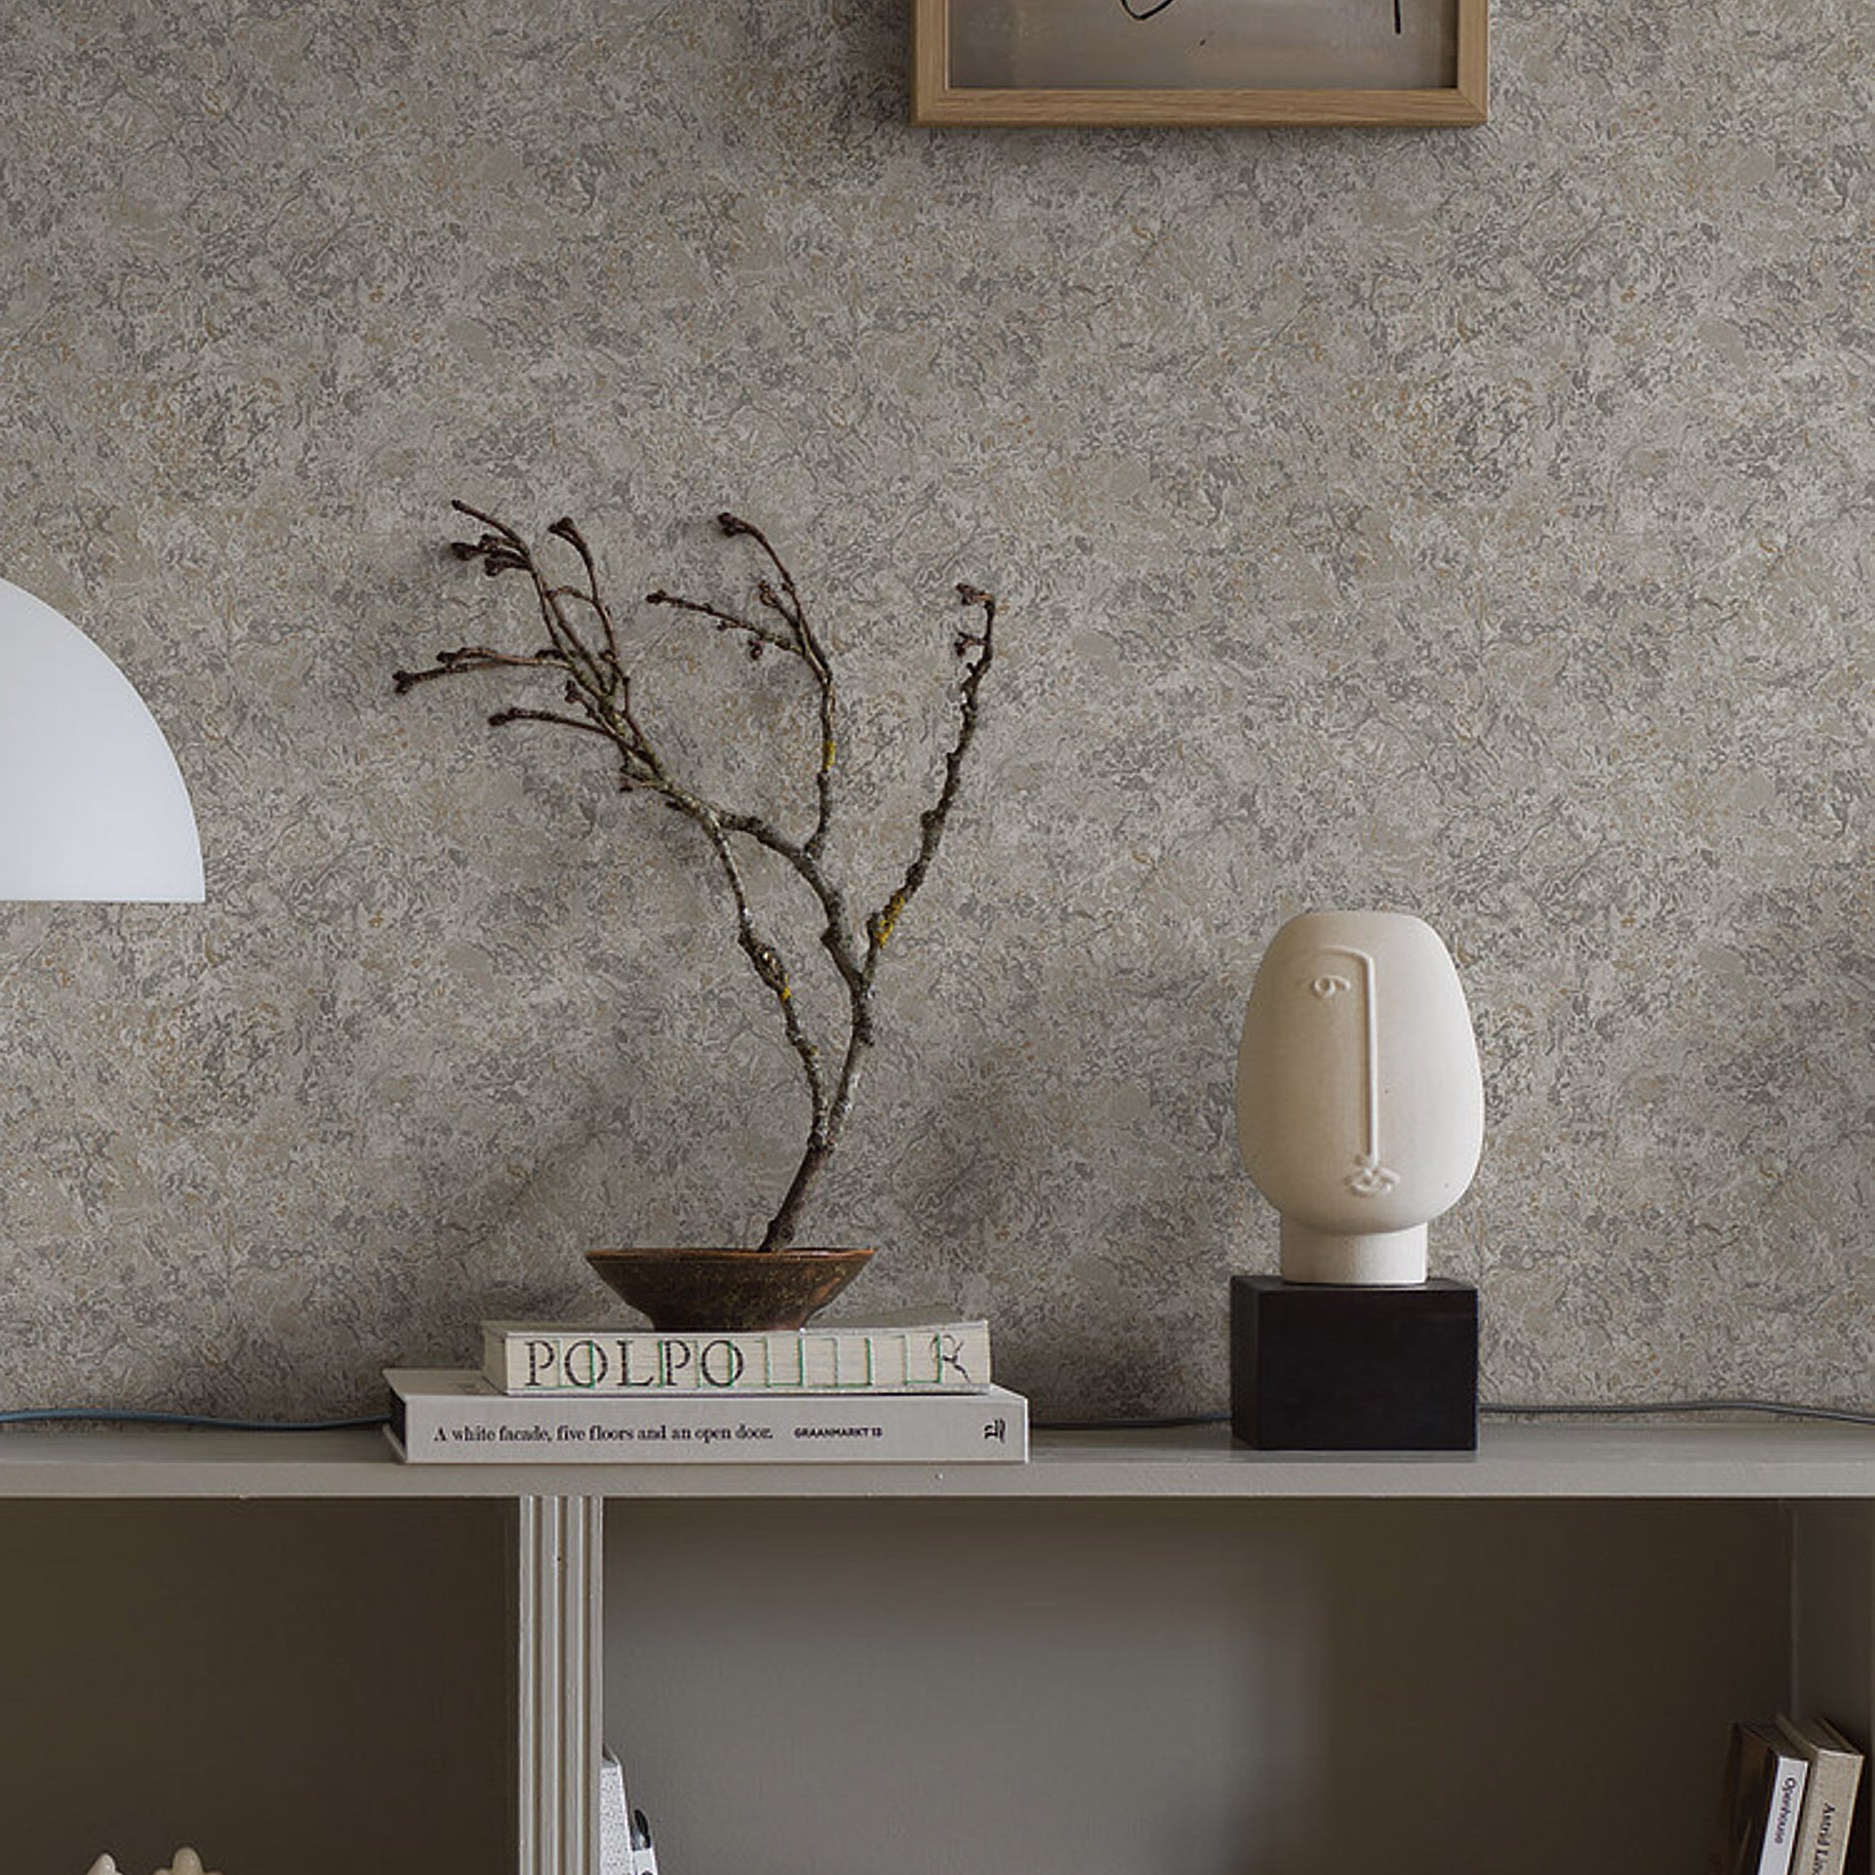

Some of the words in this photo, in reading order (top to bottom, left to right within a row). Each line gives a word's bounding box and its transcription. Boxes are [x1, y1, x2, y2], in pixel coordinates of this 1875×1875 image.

[525, 1339, 744, 1388] POLPO
[434, 1427, 447, 1441] A
[452, 1425, 495, 1441] white
[498, 1426, 553, 1443] facade,
[556, 1425, 586, 1441] five
[589, 1425, 634, 1441] floors
[637, 1425, 666, 1441] and
[671, 1428, 691, 1440] an
[694, 1428, 732, 1444] open
[734, 1424, 774, 1440] door.
[794, 1427, 869, 1439] GRAANMARKT
[1774, 1776, 1797, 1844] Openhouse
[1816, 1802, 1836, 1847] Astrid
